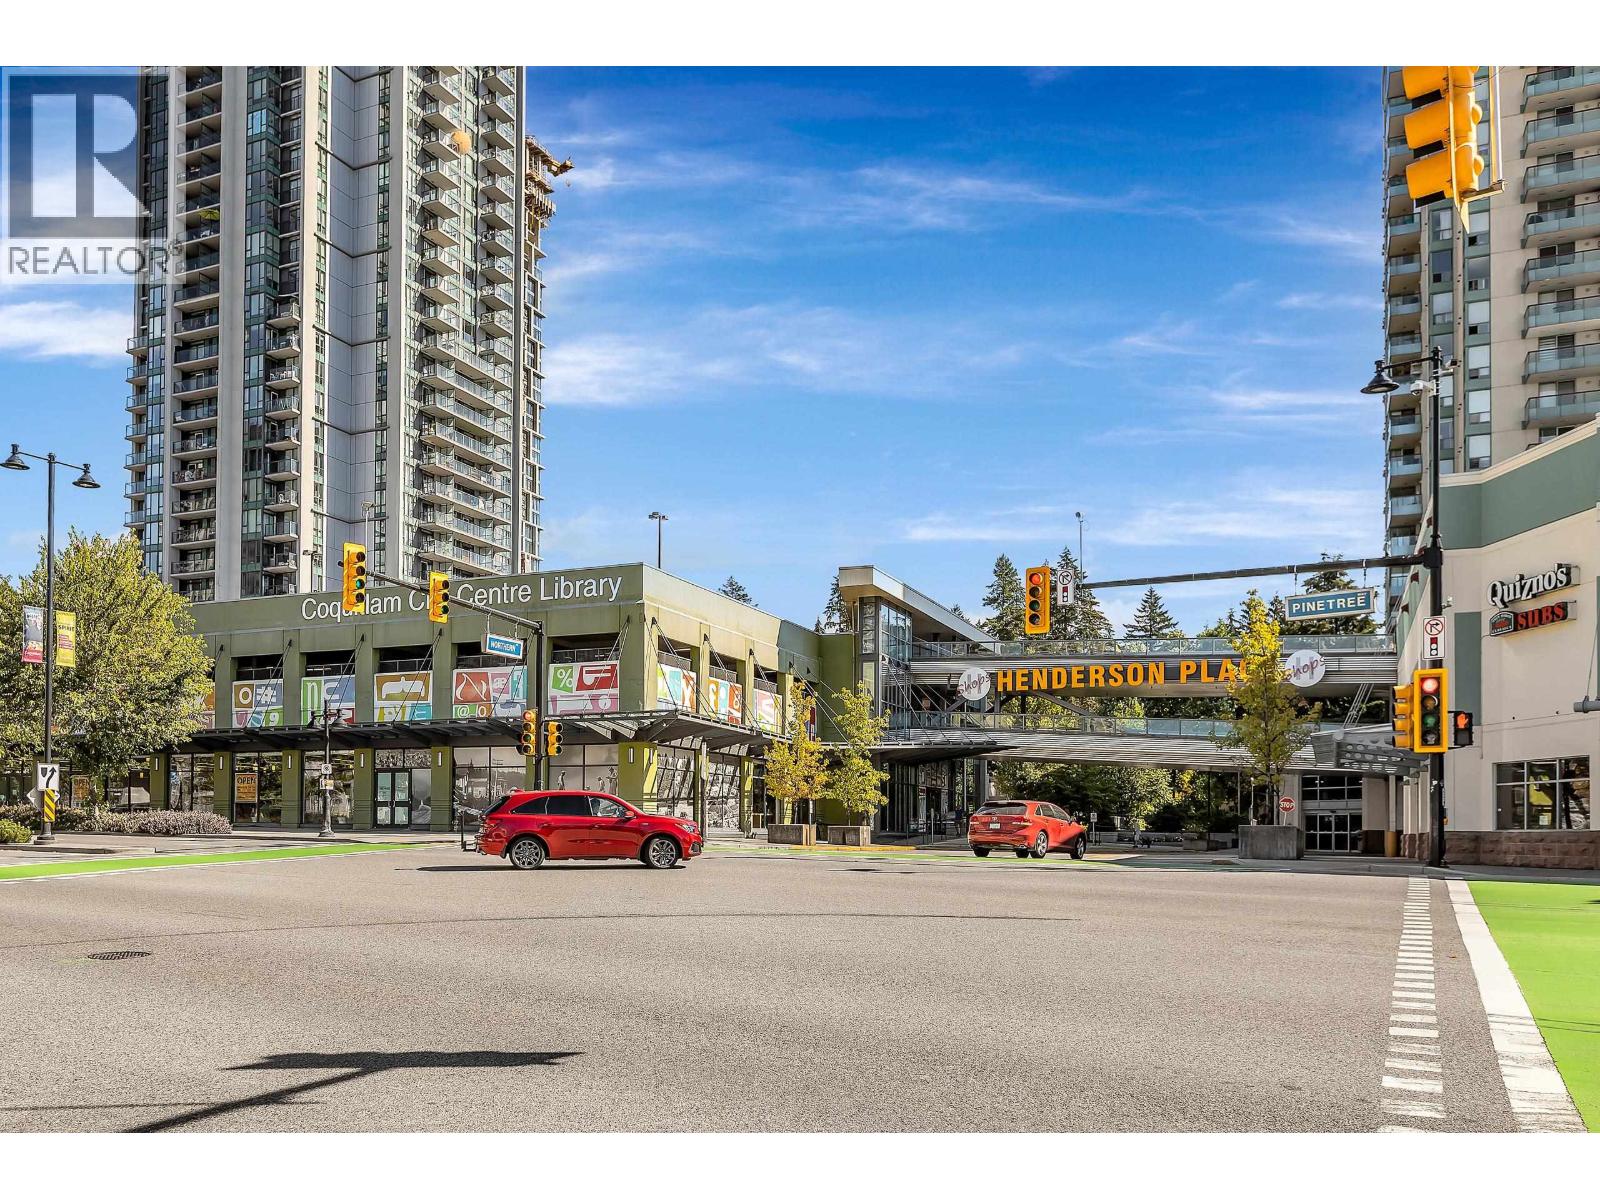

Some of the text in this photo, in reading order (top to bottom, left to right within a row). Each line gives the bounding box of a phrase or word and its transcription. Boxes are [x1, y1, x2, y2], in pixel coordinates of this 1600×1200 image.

[301, 593, 401, 622] Coqlam
[457, 582, 532, 606] Centre
[540, 575, 622, 601] Library
[1292, 596, 1366, 613] PINETREE
[1517, 602, 1566, 630] SUBS
[997, 662, 1165, 692] HENDERSON
